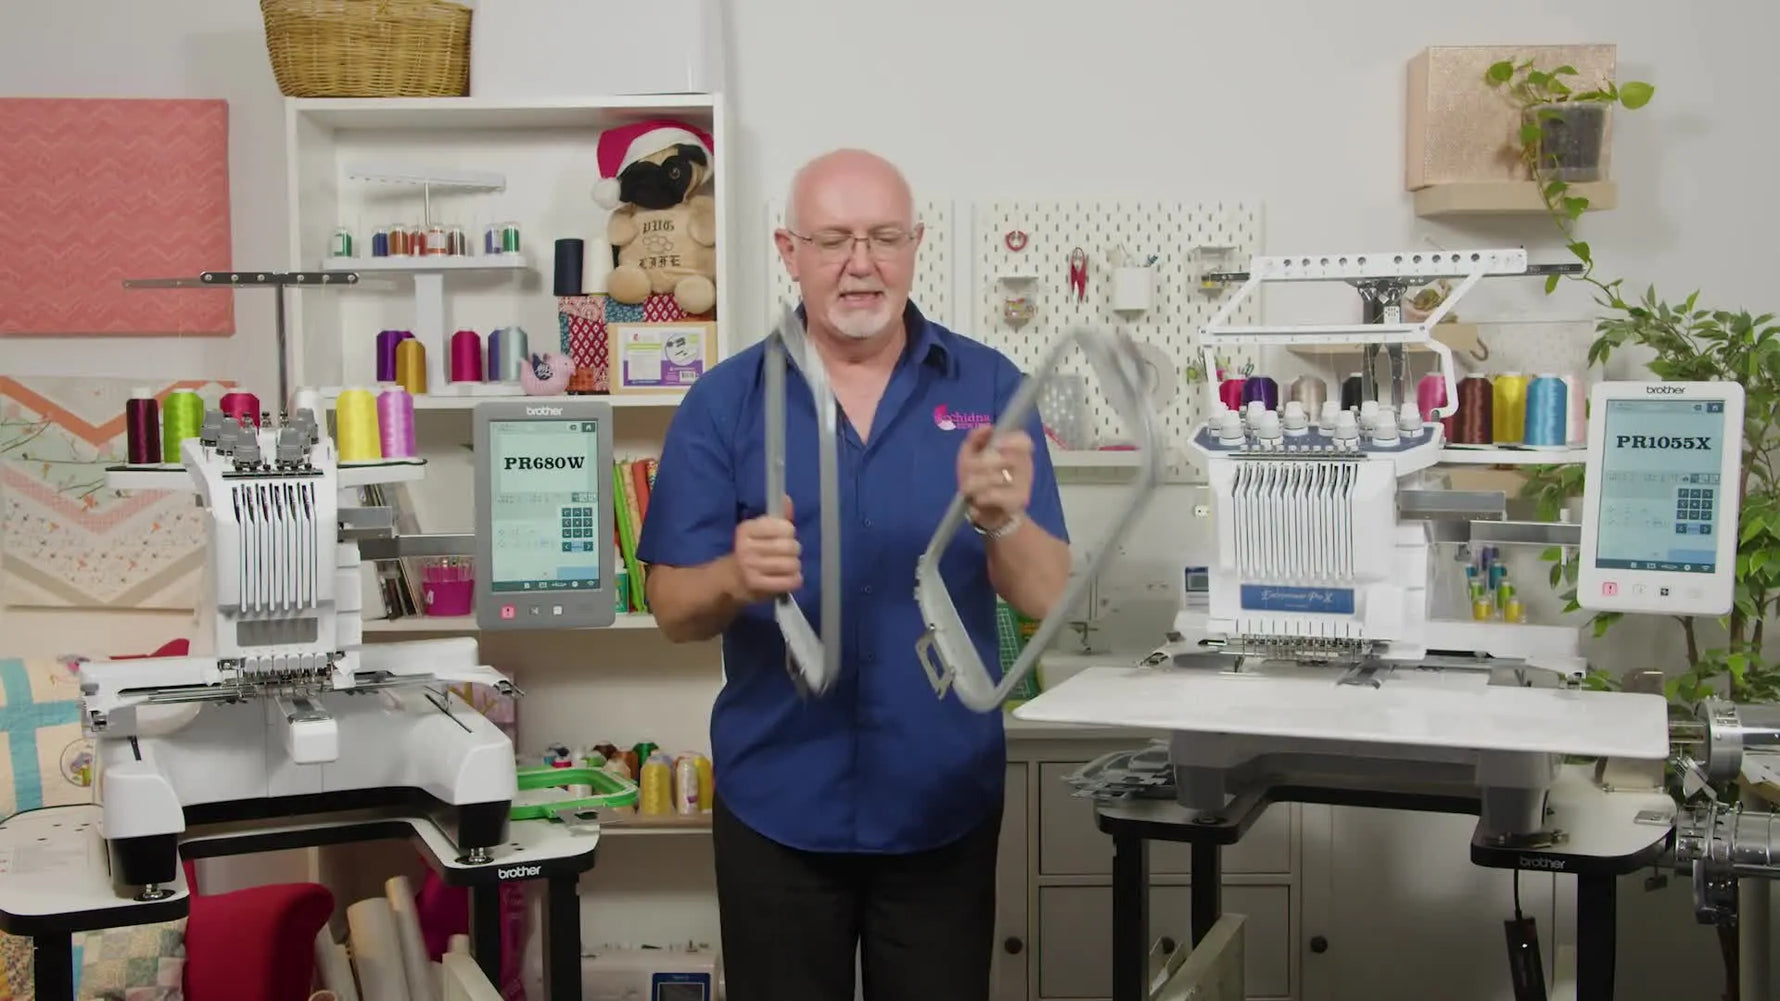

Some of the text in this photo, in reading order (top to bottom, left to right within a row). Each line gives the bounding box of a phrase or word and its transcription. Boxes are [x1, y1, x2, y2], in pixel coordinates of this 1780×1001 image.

[1646, 386, 1686, 395] brother
[526, 406, 563, 416] brother
[1616, 435, 1711, 450] PR1055X
[504, 456, 585, 470] PR680W
[1520, 855, 1566, 870] brother
[498, 866, 541, 879] brother
